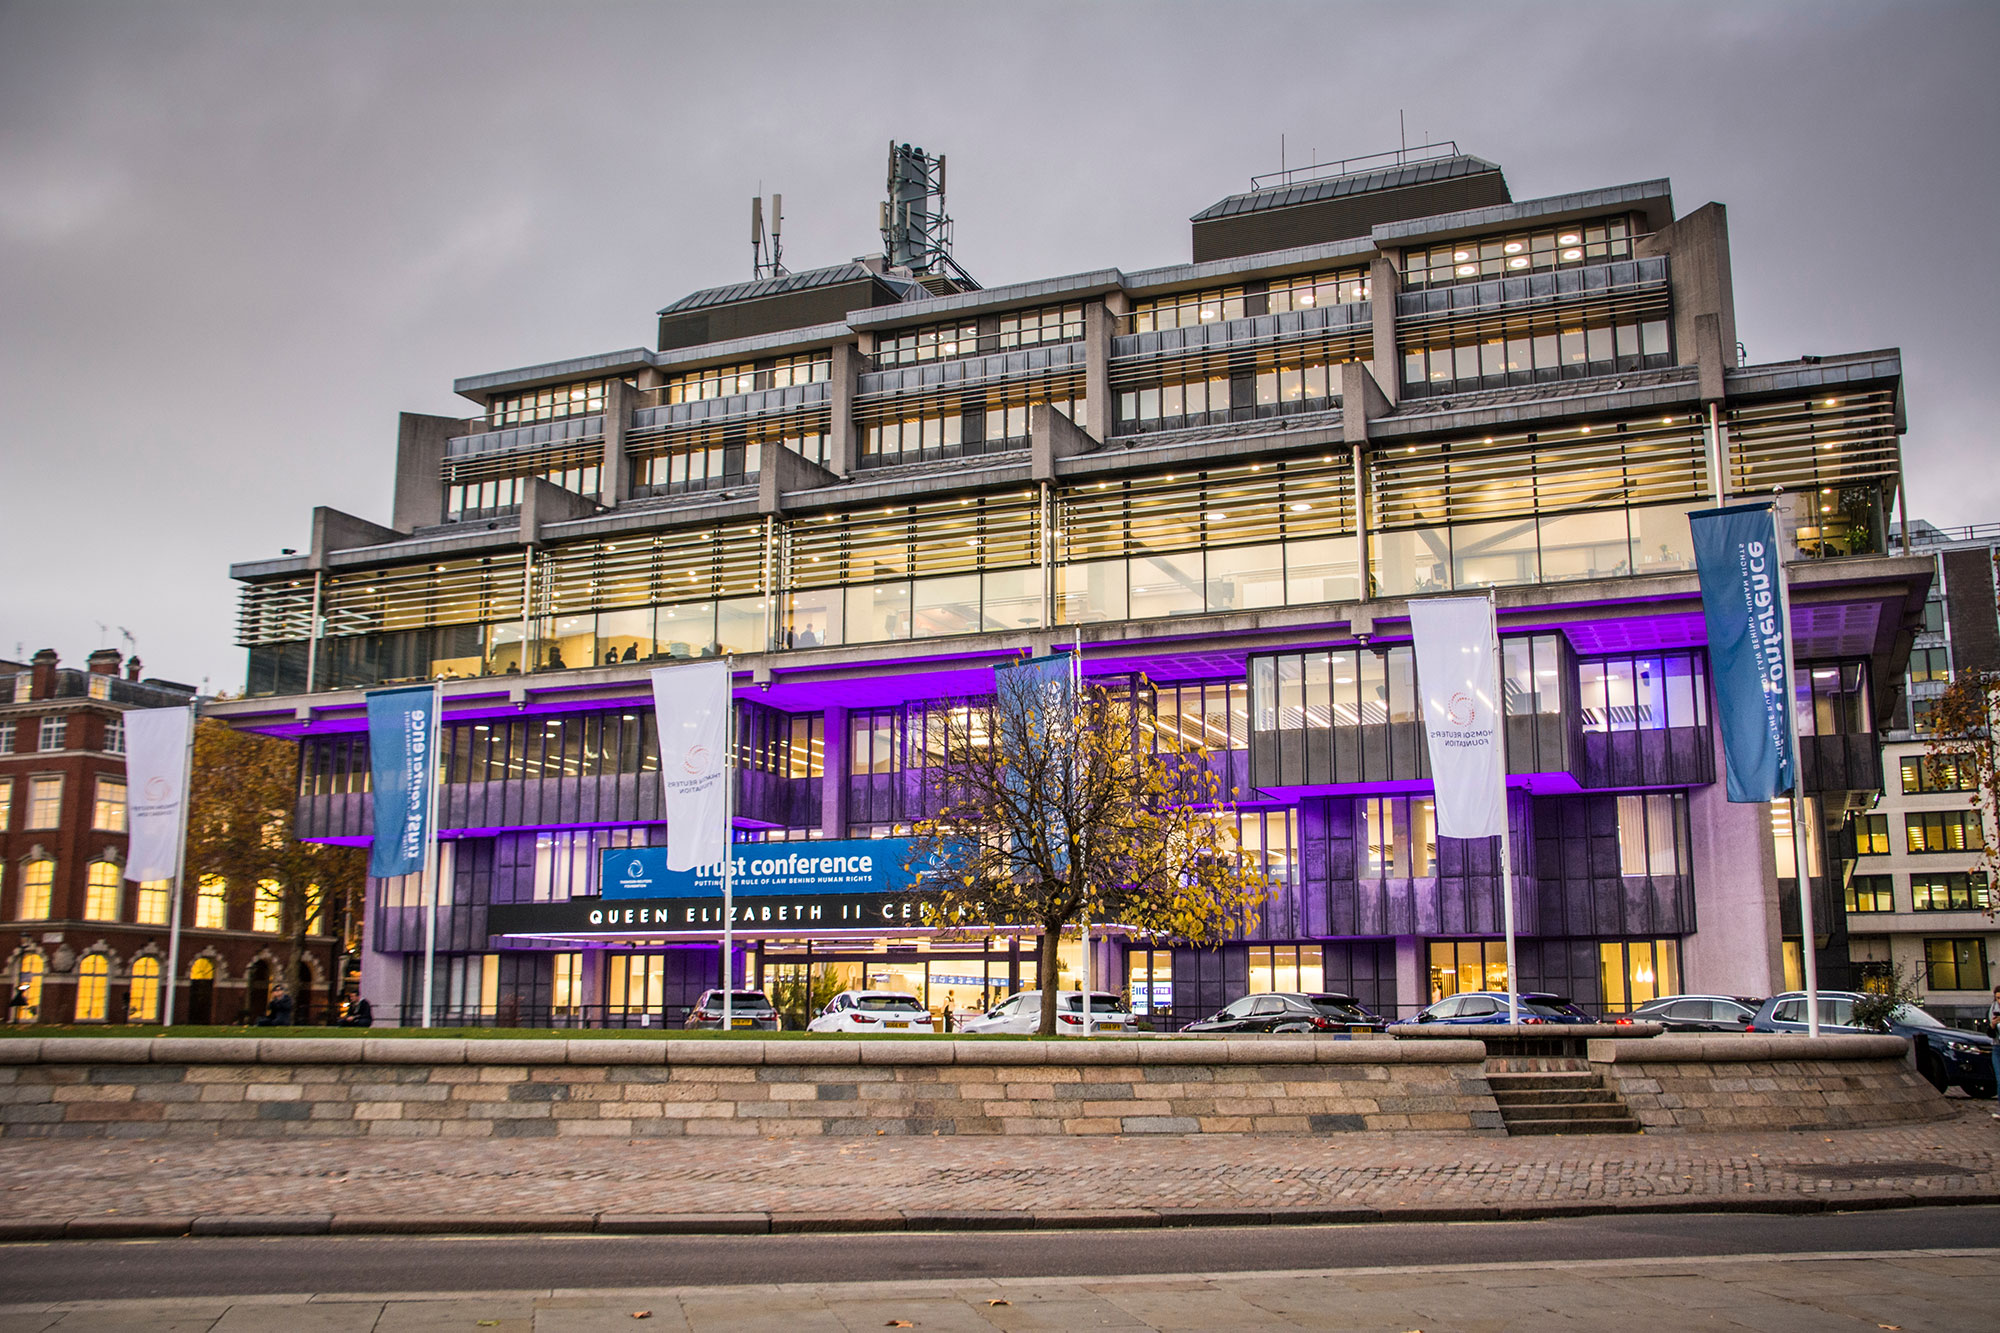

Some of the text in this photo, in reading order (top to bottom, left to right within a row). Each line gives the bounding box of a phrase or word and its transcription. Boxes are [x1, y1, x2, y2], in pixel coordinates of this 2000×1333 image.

[750, 853, 873, 875] conference
[589, 908, 668, 925] QUEEN
[686, 905, 822, 923] ELIZABETH
[842, 904, 861, 919] II
